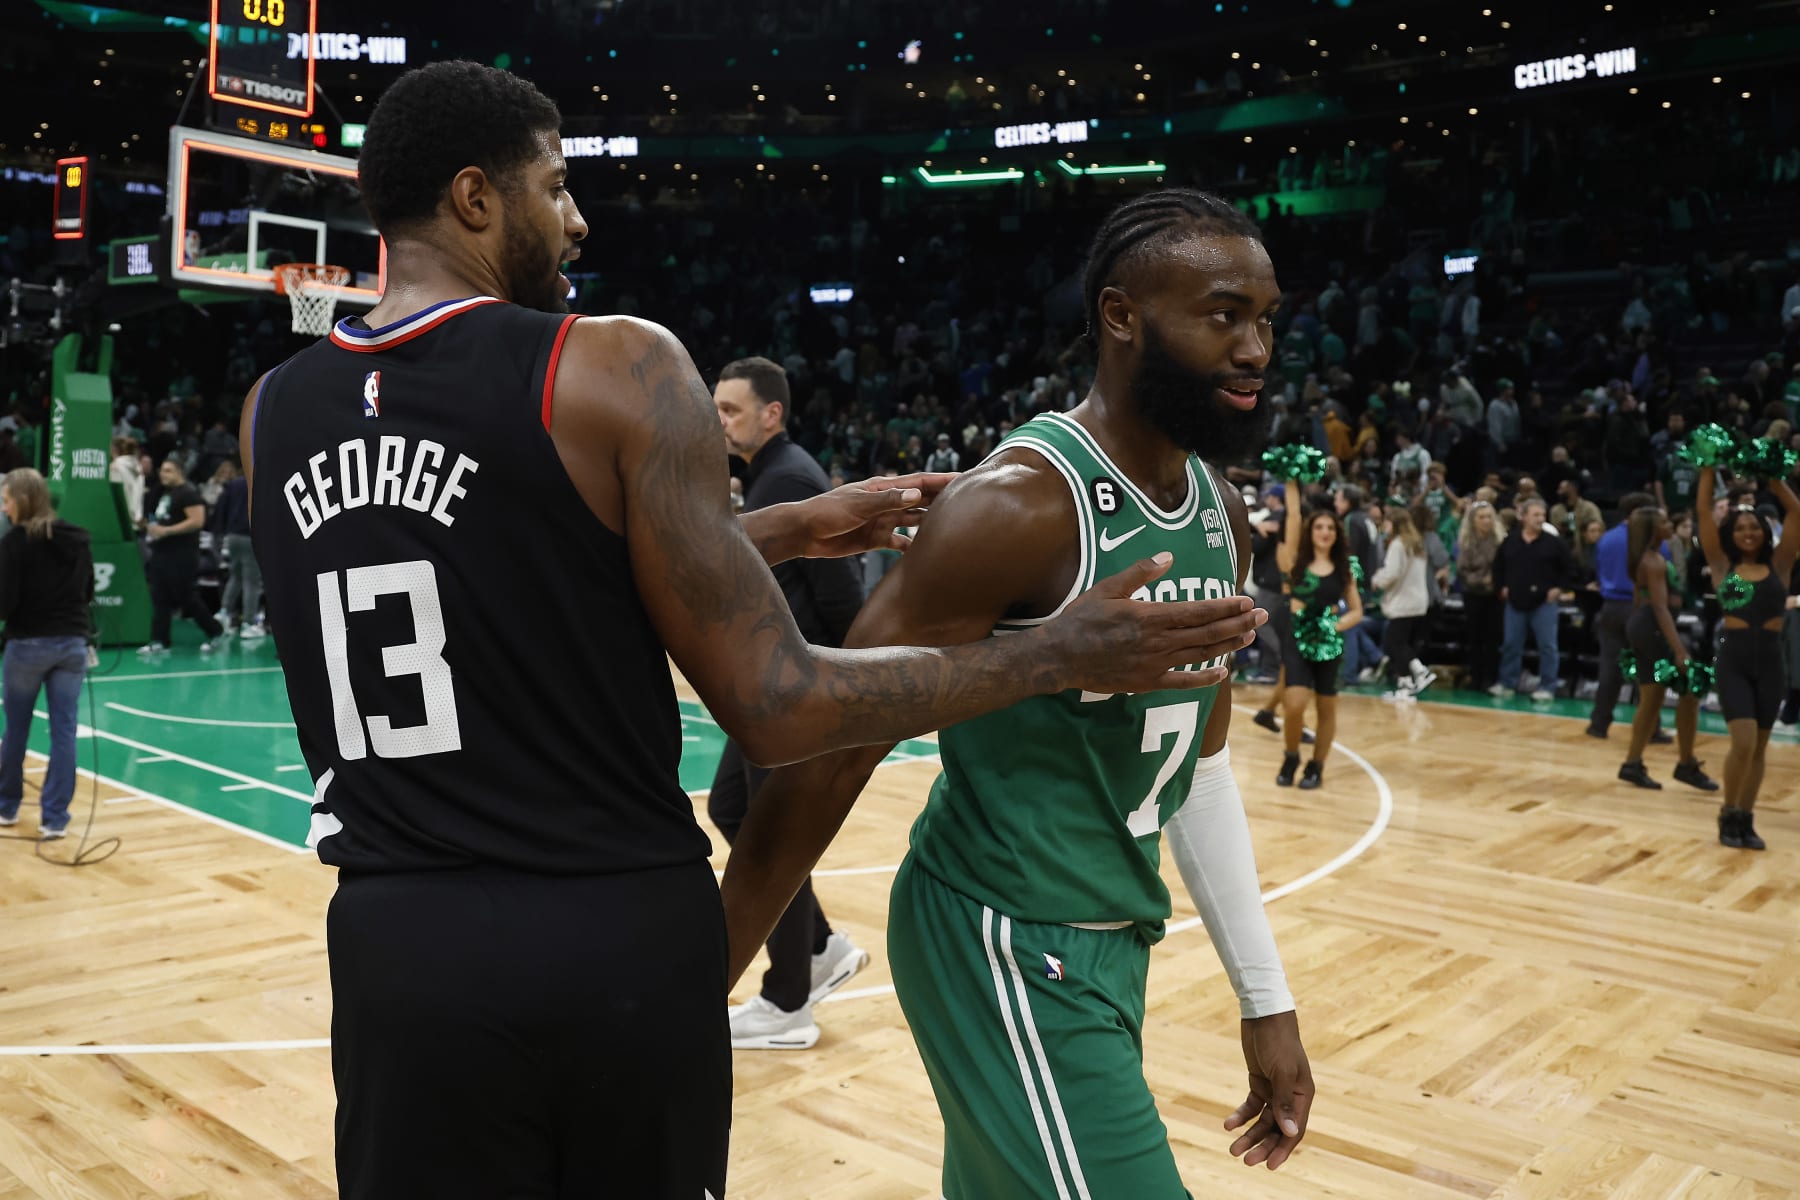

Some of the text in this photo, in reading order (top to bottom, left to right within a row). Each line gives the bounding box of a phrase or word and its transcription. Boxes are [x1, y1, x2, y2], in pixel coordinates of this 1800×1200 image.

[1514, 46, 1637, 90] CELTICS WIN
[243, 80, 306, 105] TISSOT
[994, 120, 1088, 149] CELTICS WIN
[72, 448, 107, 466] VISTA
[72, 465, 106, 480] PRINT
[283, 435, 480, 540] GEORGE
[1095, 482, 1117, 512] 6
[1200, 508, 1222, 532] VISTA
[1205, 531, 1225, 549] PRINT
[317, 559, 462, 761] 13
[1126, 700, 1200, 839] 7
